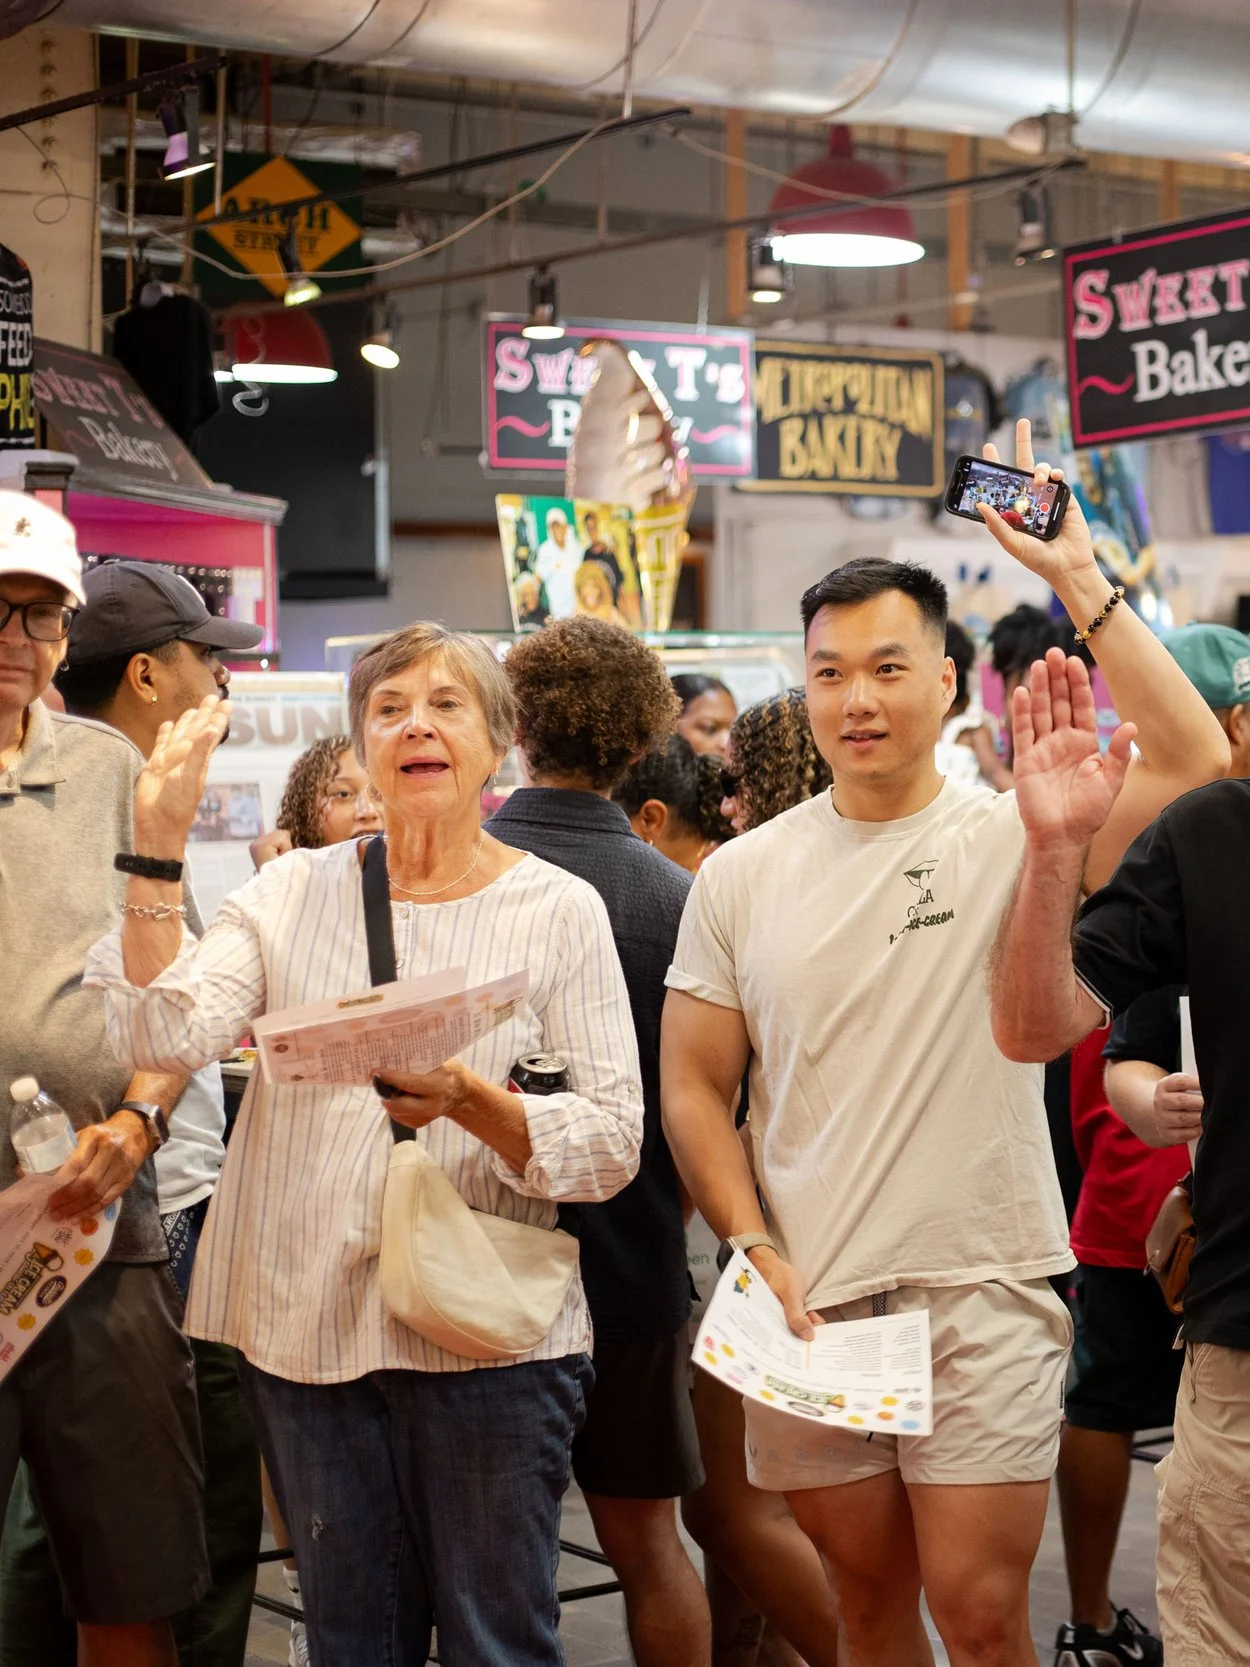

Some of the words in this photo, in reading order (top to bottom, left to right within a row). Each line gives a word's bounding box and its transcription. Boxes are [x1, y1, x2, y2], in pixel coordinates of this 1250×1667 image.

[778, 413, 903, 482] BAKERY
[225, 705, 343, 746] SUN
[24, 1260, 43, 1279] ICE
[0, 1275, 31, 1315] CREAM
